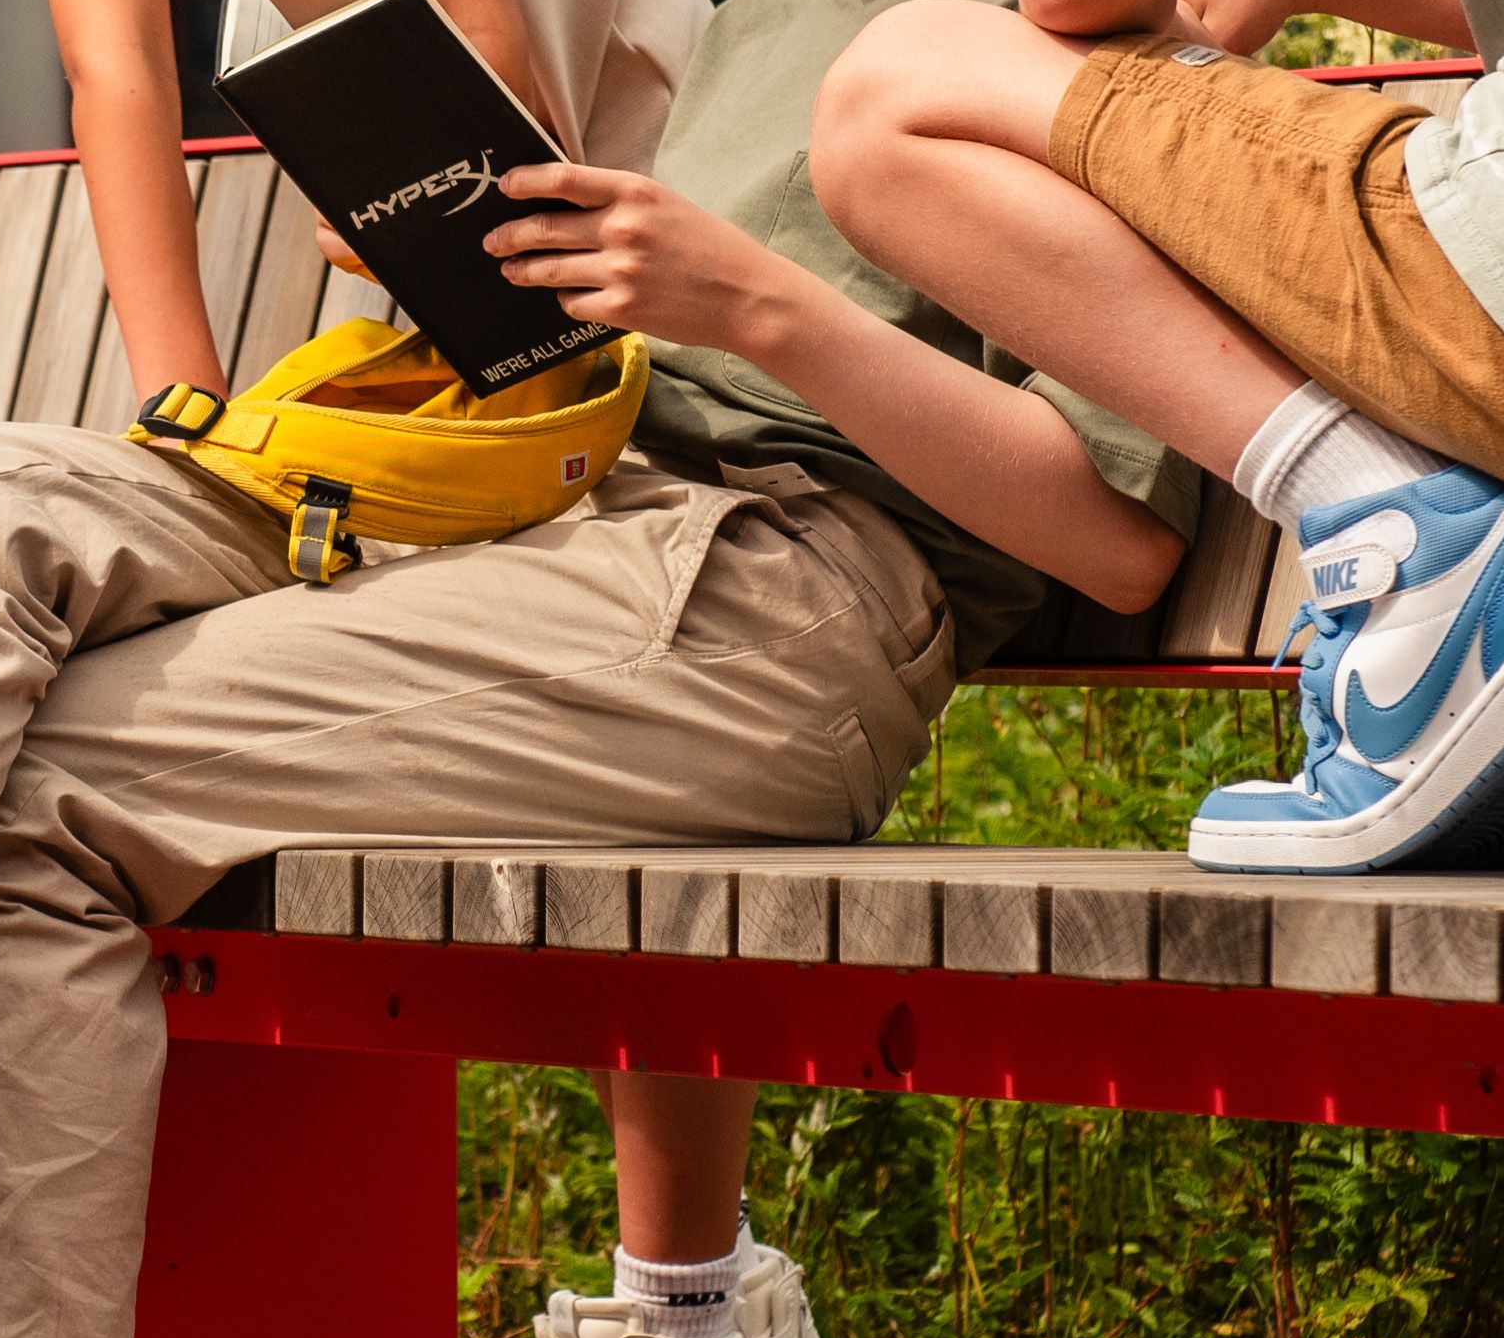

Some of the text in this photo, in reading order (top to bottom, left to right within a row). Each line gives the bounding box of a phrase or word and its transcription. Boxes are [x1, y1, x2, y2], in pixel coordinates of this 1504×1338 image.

[481, 321, 612, 383] WE'RE ALL GAME
[1312, 557, 1360, 598] NIKE
